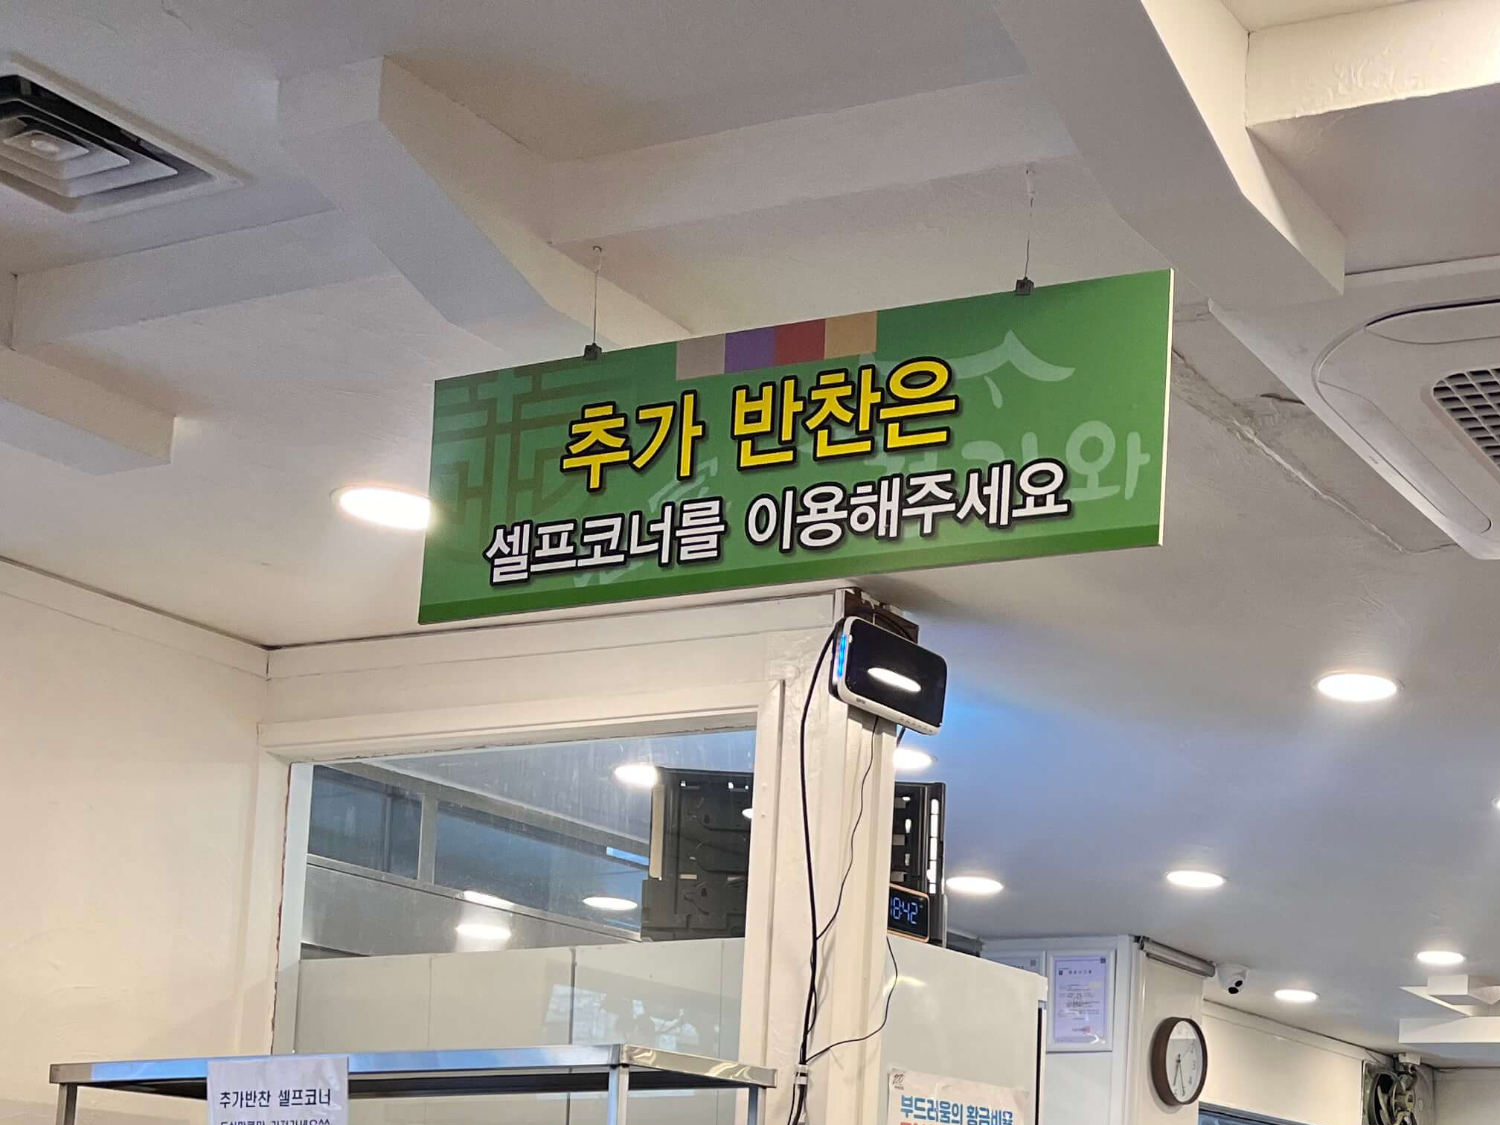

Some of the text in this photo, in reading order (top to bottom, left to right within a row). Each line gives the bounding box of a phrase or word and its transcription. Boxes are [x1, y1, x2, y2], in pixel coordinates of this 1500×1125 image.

[562, 390, 703, 491] 추가
[731, 356, 958, 470] 반찬은
[485, 460, 1072, 586] 셀프코너를 이용해주세요
[219, 1088, 331, 1109] 추가반찬 셀프코너
[900, 1095, 963, 1125] 부드러움의
